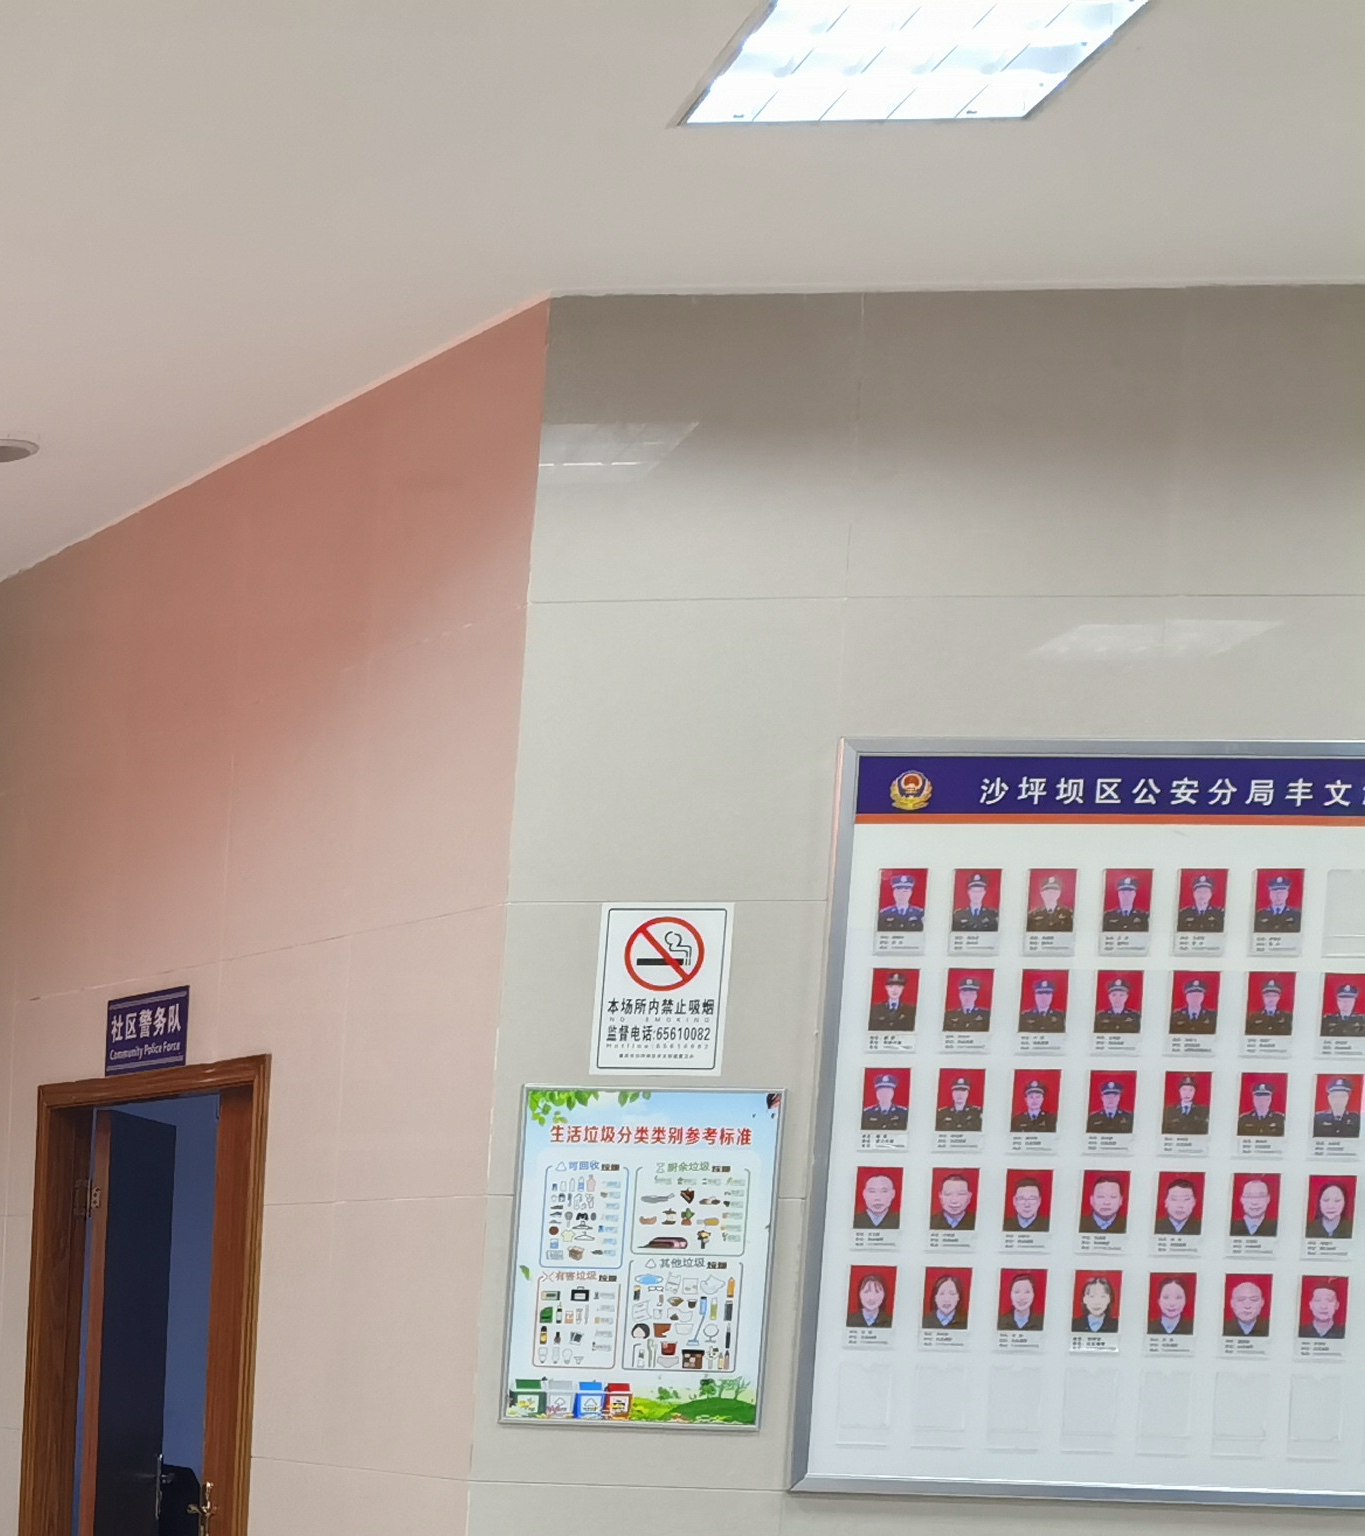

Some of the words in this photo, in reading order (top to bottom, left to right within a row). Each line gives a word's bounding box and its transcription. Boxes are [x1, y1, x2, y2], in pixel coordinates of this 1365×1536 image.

[980, 775, 1365, 809] 沙坪坝区公安分局丰文
[607, 998, 715, 1015] 本场所内禁止吸烟
[111, 1003, 181, 1043] 社区警务队
[606, 1025, 711, 1041] 监督电话:65610082
[109, 1046, 144, 1061] Community
[144, 1042, 162, 1056] Police
[163, 1041, 181, 1053] Force
[549, 1125, 753, 1146] 生活垃圾分类类别参考标准
